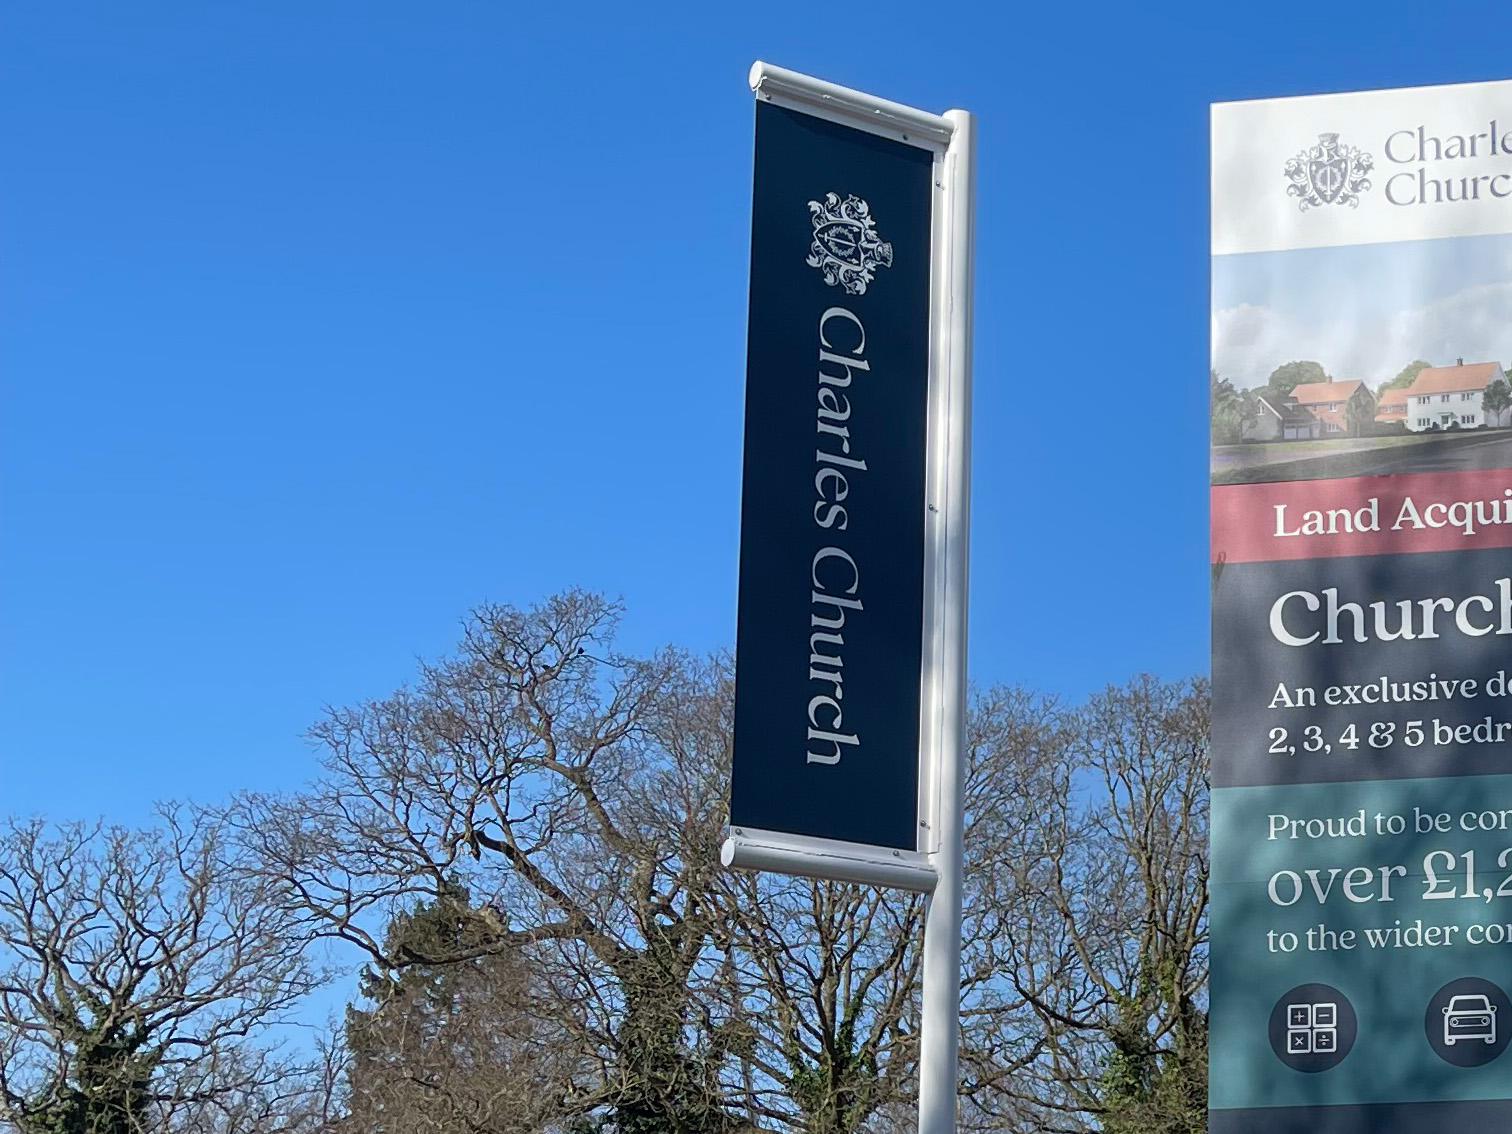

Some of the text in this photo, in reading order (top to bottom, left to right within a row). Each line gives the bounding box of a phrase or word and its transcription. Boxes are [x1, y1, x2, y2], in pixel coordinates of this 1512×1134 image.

[805, 306, 872, 768] Charles Church
[1273, 498, 1380, 537] Land
[1268, 682, 1315, 709] An
[1323, 670, 1478, 705] exclusive
[1268, 727, 1297, 756] 2,
[1303, 723, 1332, 753] 3,
[1338, 723, 1360, 750] 4
[1368, 721, 1395, 748] &
[1403, 719, 1425, 747] 5
[1267, 809, 1366, 840] Proud
[1373, 812, 1404, 836] to
[1414, 807, 1452, 835] be
[1268, 862, 1407, 905] over
[1266, 928, 1299, 953] to
[1305, 924, 1356, 951] the
[1364, 918, 1459, 949] wider
